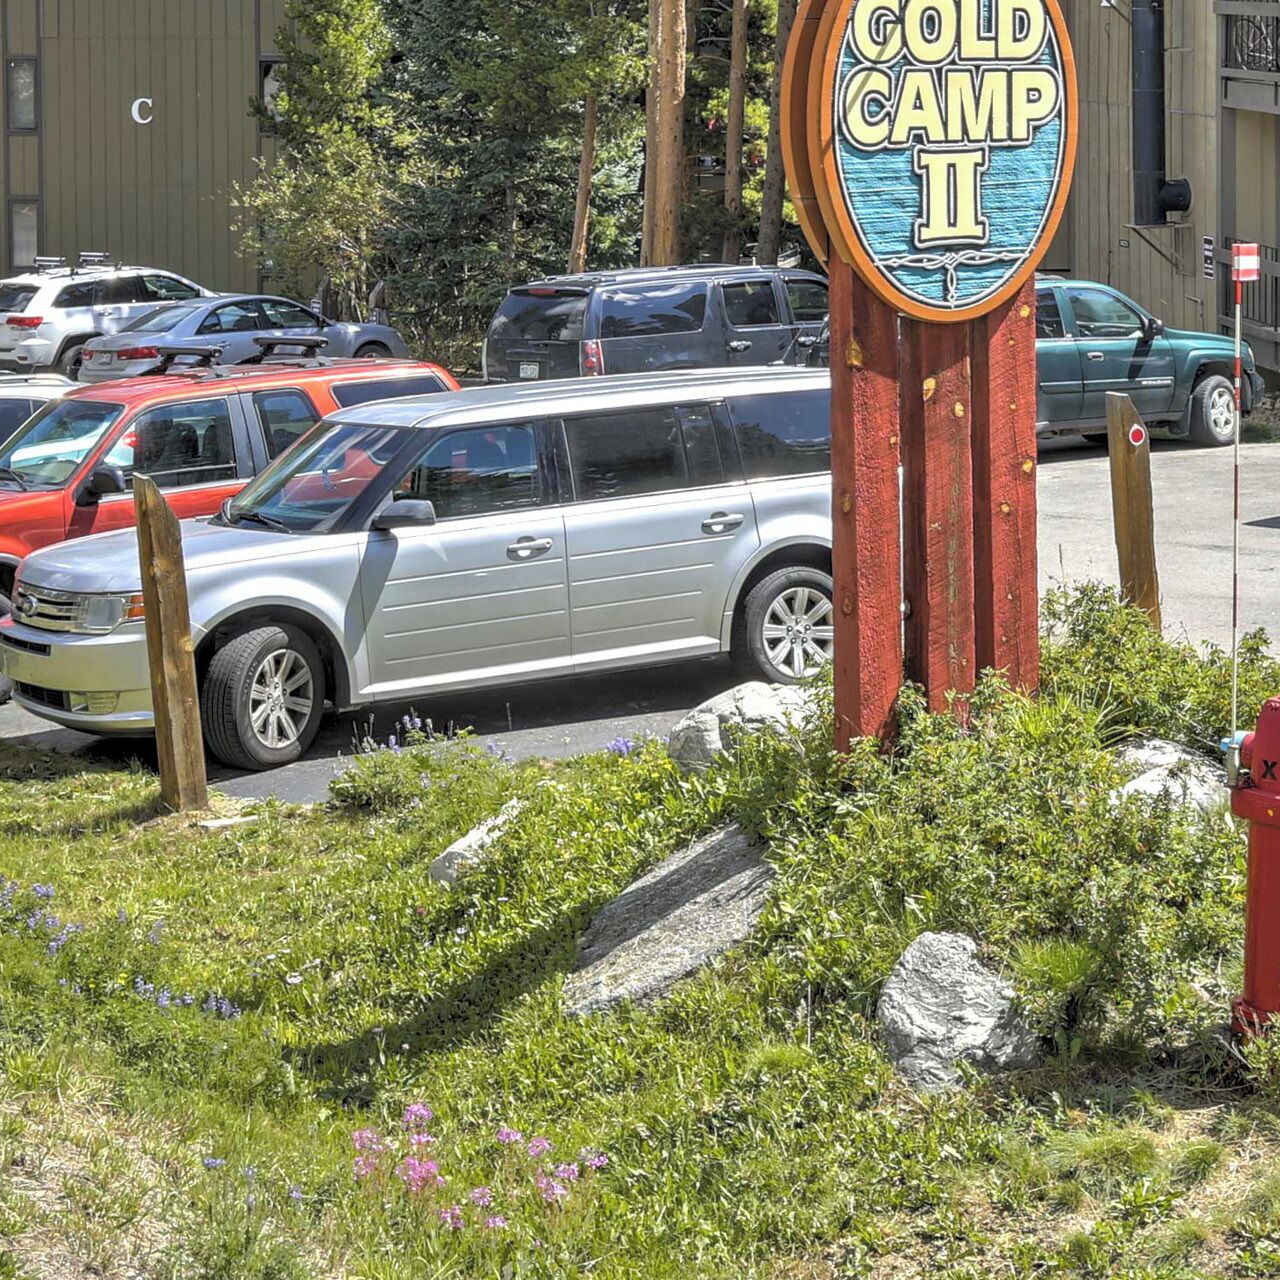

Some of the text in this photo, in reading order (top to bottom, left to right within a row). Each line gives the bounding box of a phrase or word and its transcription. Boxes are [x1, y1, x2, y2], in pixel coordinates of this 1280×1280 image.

[131, 97, 153, 124] C
[842, 67, 1061, 147] CAMP
[917, 149, 988, 243] II
[1261, 759, 1278, 781] X
